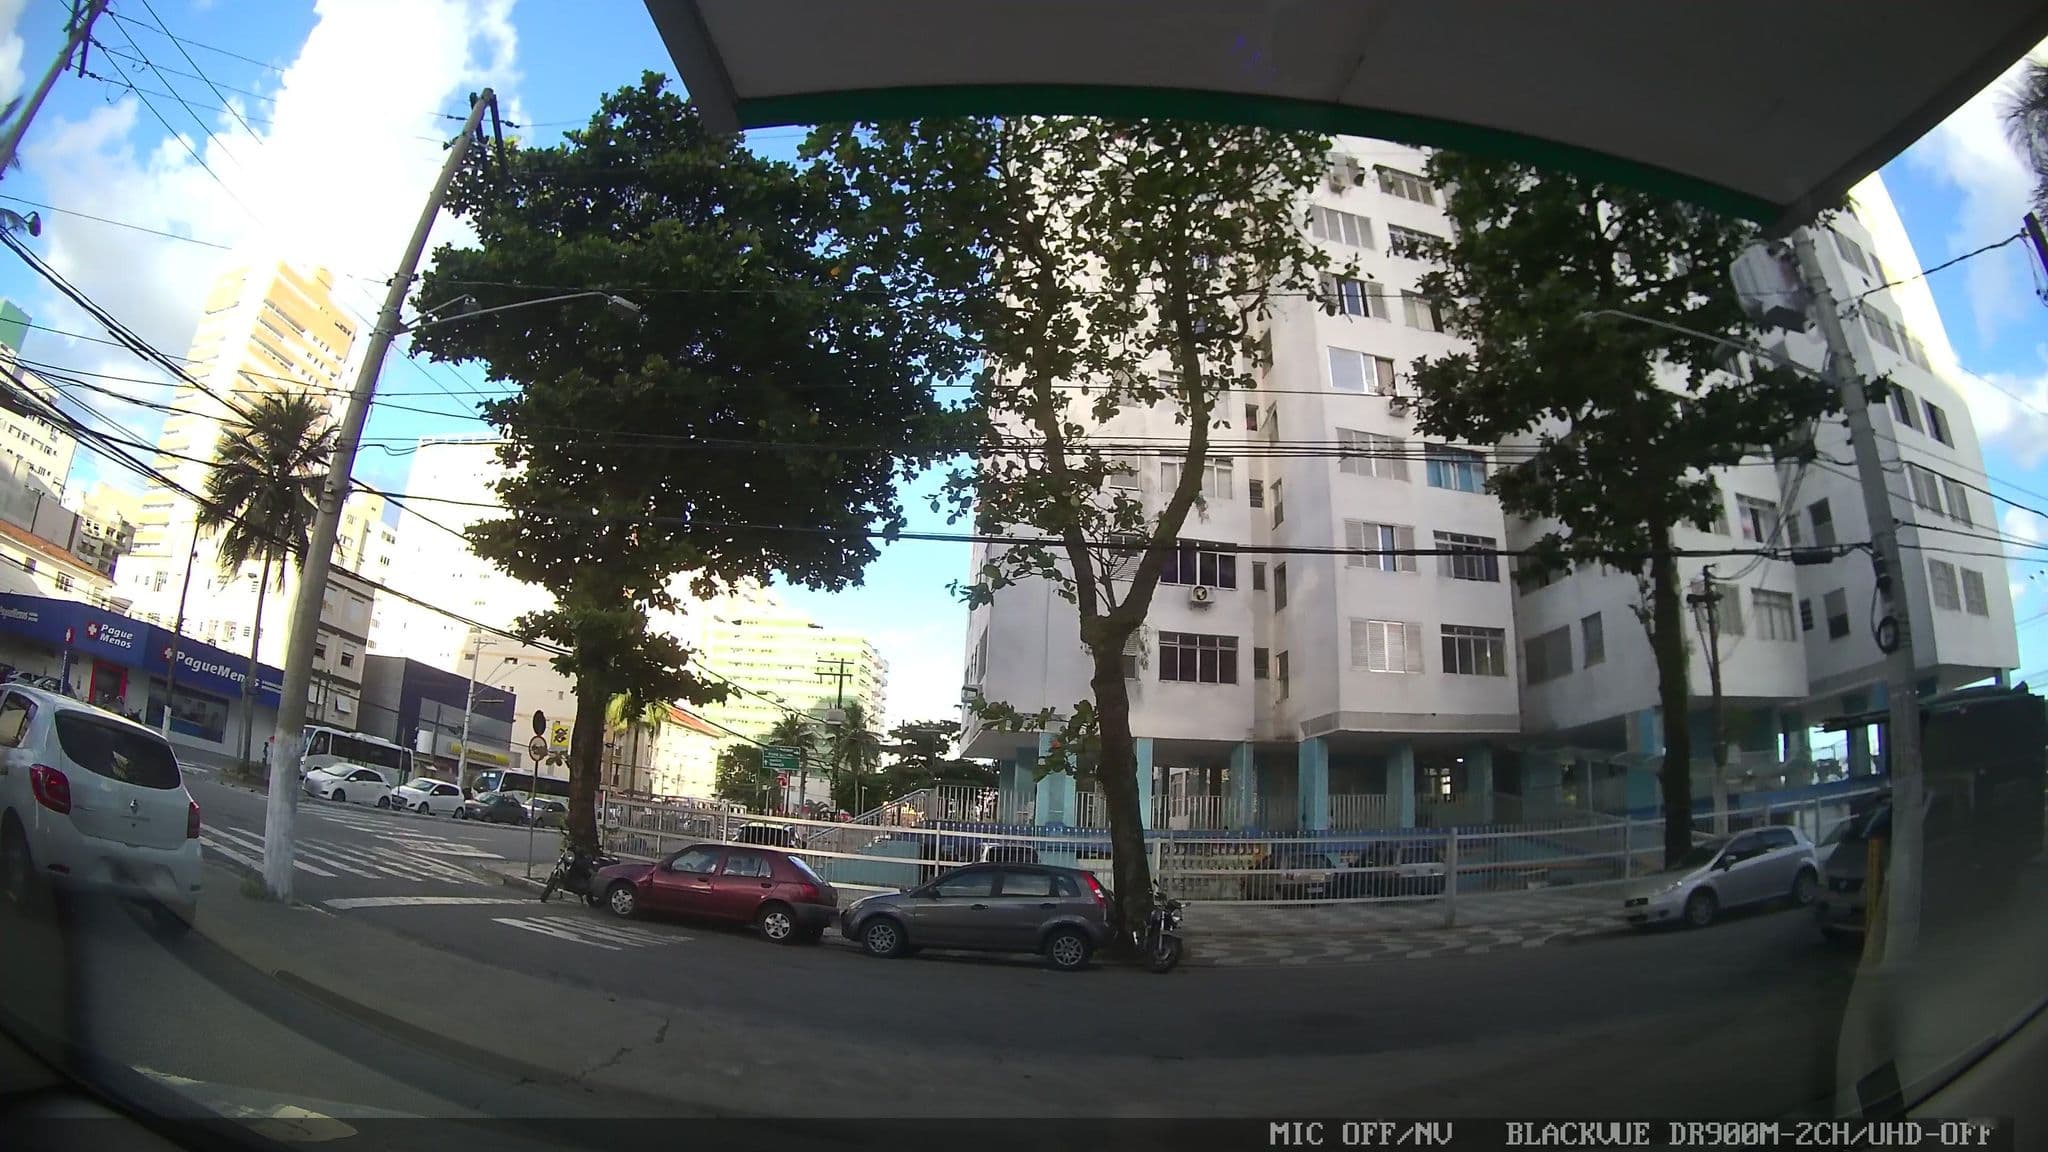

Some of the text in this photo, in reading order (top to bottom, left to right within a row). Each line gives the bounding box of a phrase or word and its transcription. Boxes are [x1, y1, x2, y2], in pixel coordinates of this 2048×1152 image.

[101, 624, 133, 639] Pague
[100, 633, 132, 649] Menos
[176, 651, 260, 687] PagueMens
